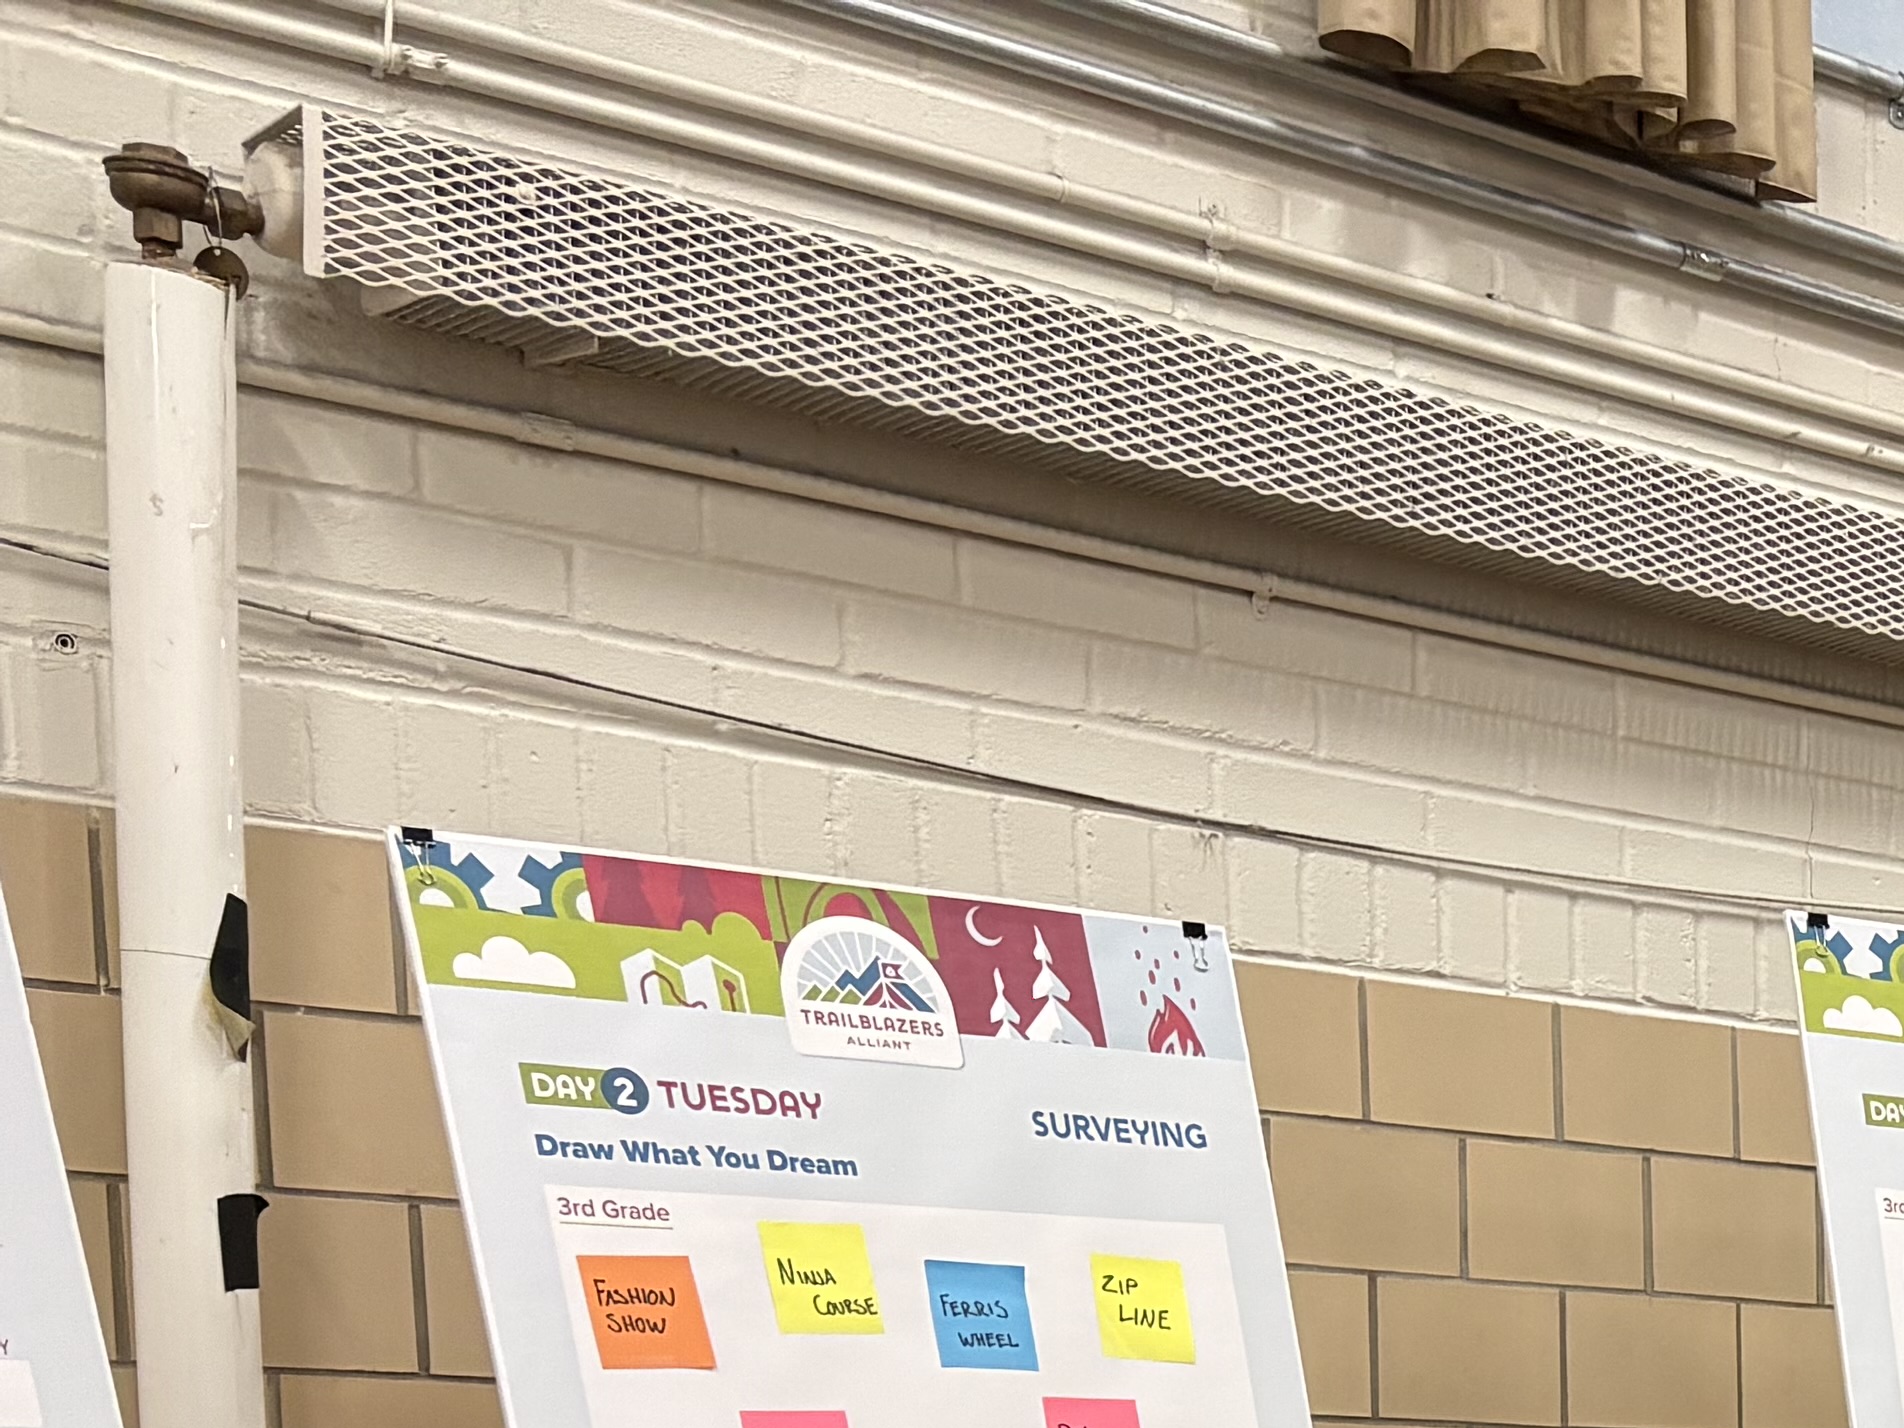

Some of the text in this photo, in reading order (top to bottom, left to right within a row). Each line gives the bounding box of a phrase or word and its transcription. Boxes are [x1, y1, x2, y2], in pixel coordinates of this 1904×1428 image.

[800, 1010, 945, 1038] TRAILBLAZERS
[846, 1035, 912, 1053] ALLIANT
[531, 1070, 823, 1121] DAY 2 TUESDAY
[1031, 1111, 1208, 1149] SURVEYING
[535, 1134, 859, 1178] Draw What You Dream
[557, 1197, 671, 1223] 3rd Grade
[777, 1259, 837, 1287] NINJA
[1101, 1275, 1138, 1295] ZIP
[594, 1279, 676, 1308] FASHION
[813, 1294, 879, 1317] COURSE
[940, 1294, 1009, 1321] FERRIS
[1118, 1304, 1172, 1331] LINE
[606, 1312, 667, 1334] SHOW
[958, 1330, 1020, 1349] WHEEL
